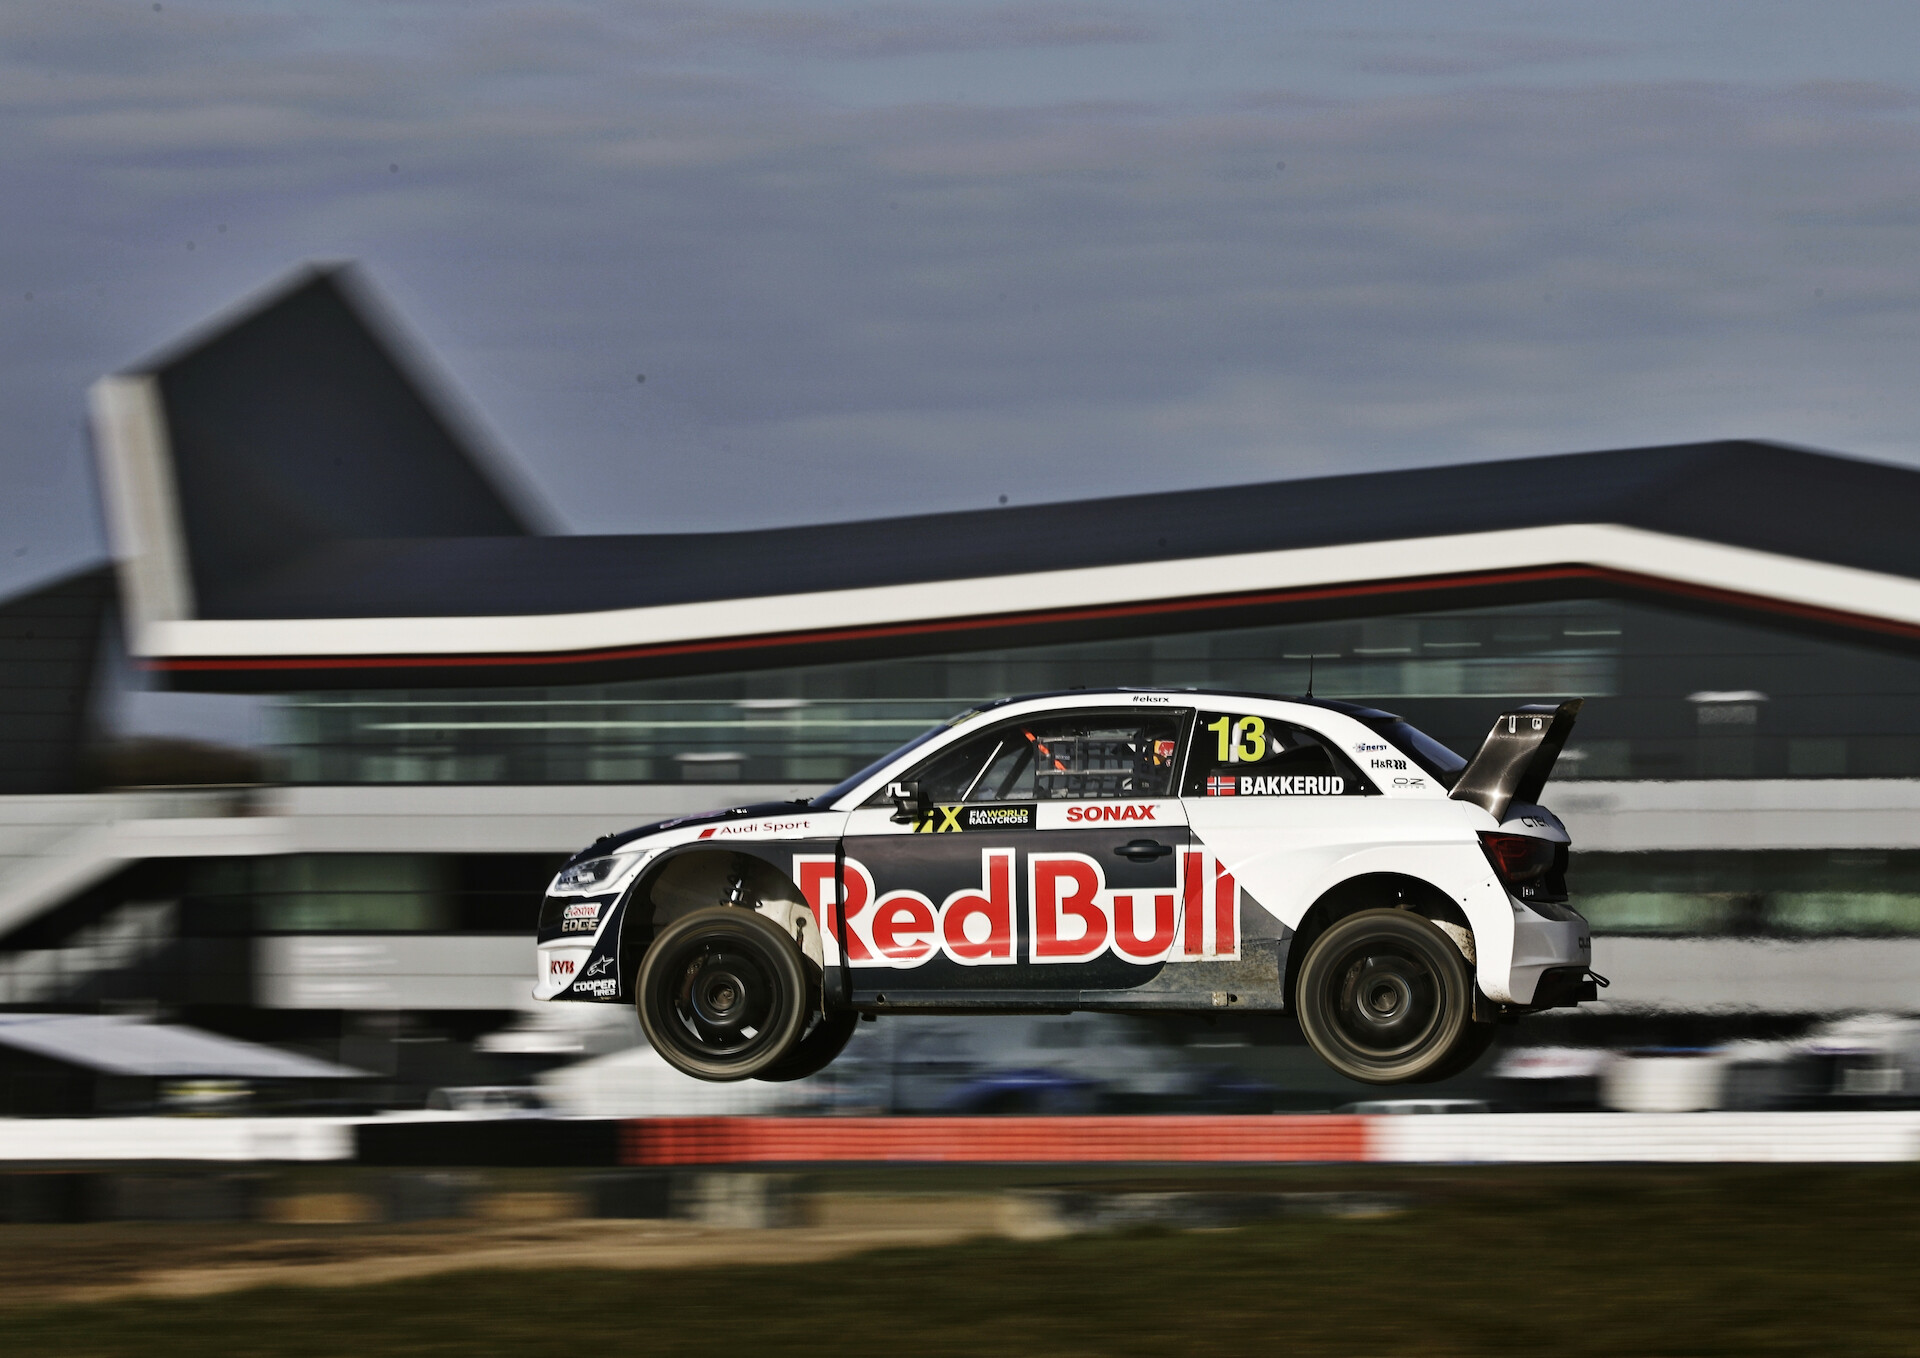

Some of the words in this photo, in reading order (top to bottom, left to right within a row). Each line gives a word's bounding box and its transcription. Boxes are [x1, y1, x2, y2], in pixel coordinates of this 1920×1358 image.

[1132, 695, 1170, 703] #eksrx
[1207, 716, 1266, 762] 13
[1371, 759, 1393, 769] H&R
[1240, 776, 1345, 795] BAKKERUD
[1393, 777, 1424, 786] OZ
[1066, 804, 1157, 822] SONAX
[720, 823, 758, 835] Audi
[763, 820, 811, 833] Sport
[969, 815, 1029, 826] RALLYCROSS
[795, 849, 1016, 967] Red
[1029, 846, 1240, 964] Bull
[562, 918, 600, 932] EDGE
[551, 960, 575, 974] KYB
[573, 978, 616, 992] COOPER
[593, 988, 616, 997] TIRES
